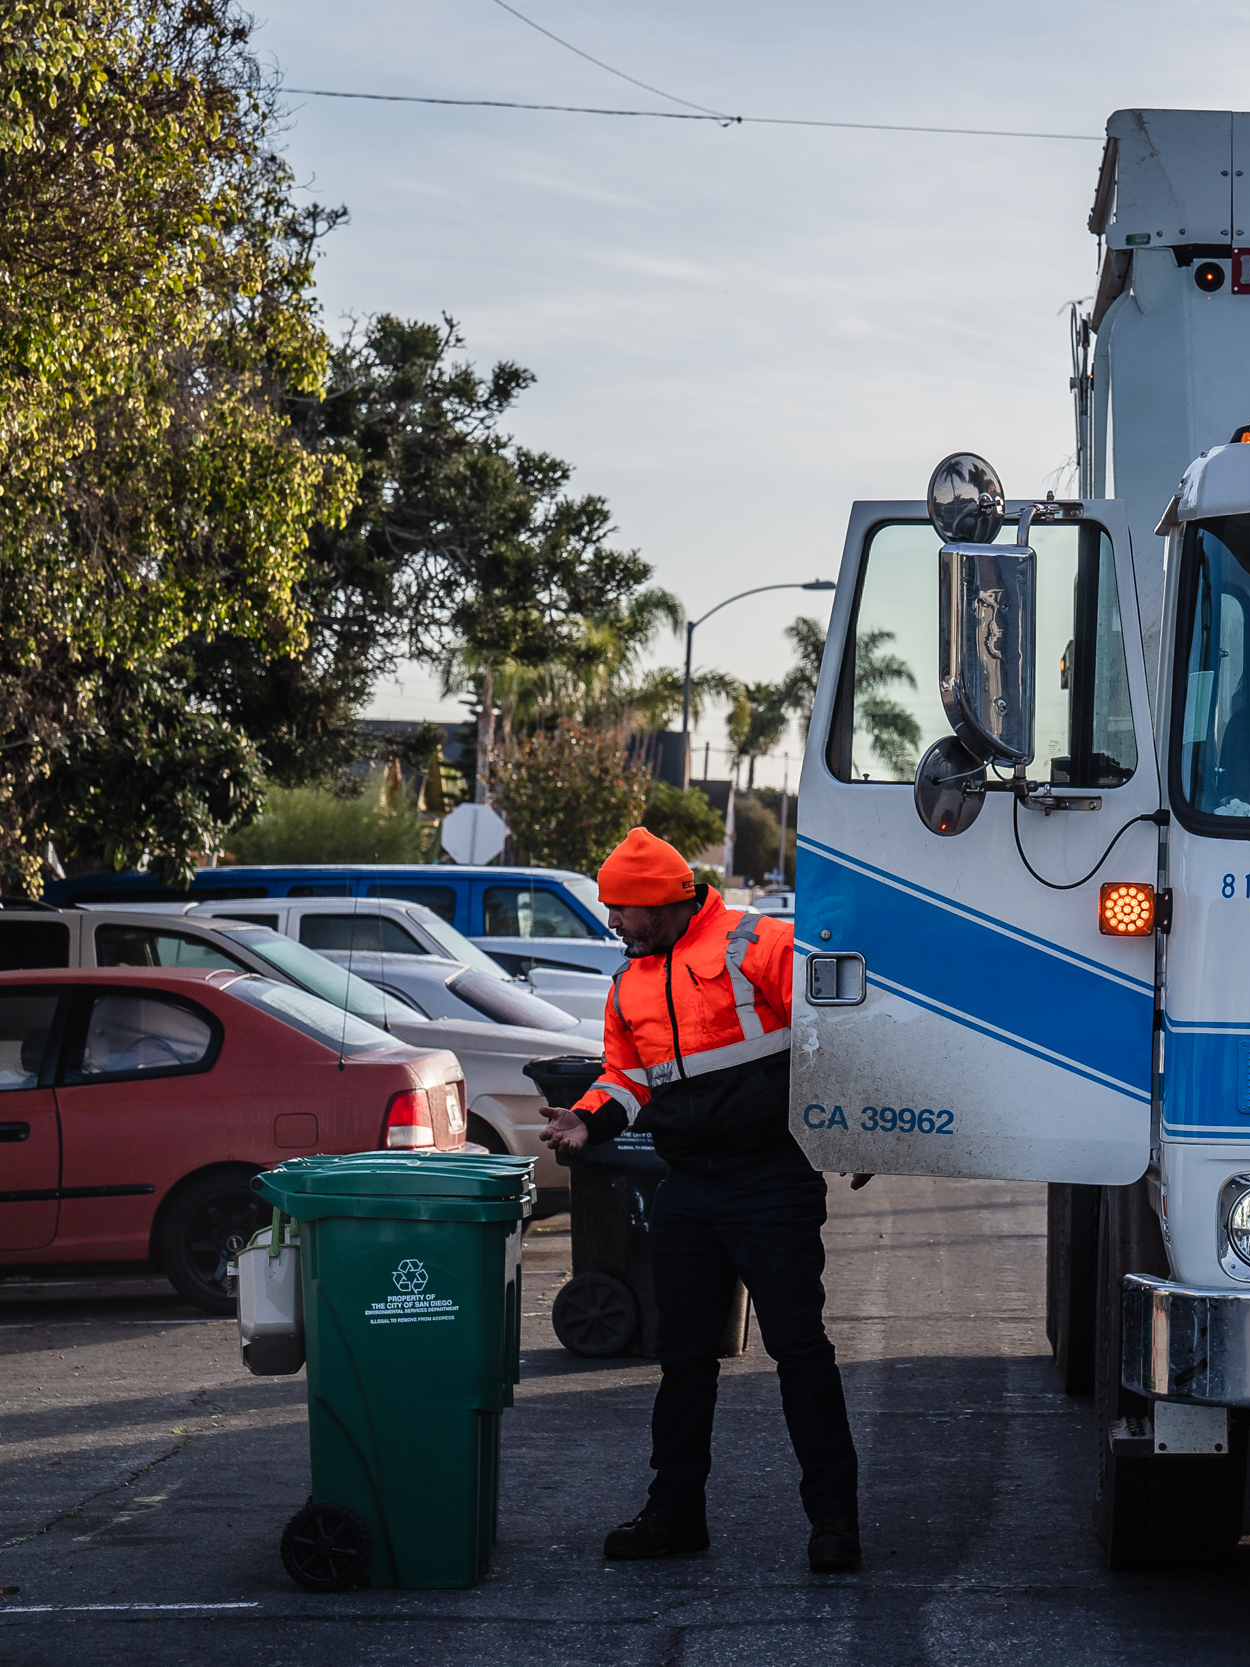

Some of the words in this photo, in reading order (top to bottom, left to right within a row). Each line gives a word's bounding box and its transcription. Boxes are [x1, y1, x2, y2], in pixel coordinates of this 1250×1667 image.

[803, 1104, 849, 1130] CA
[860, 1106, 955, 1135] 39962
[387, 1294, 425, 1302] PROPERTY
[414, 1300, 430, 1308] SAN
[430, 1299, 453, 1307] DIEGO
